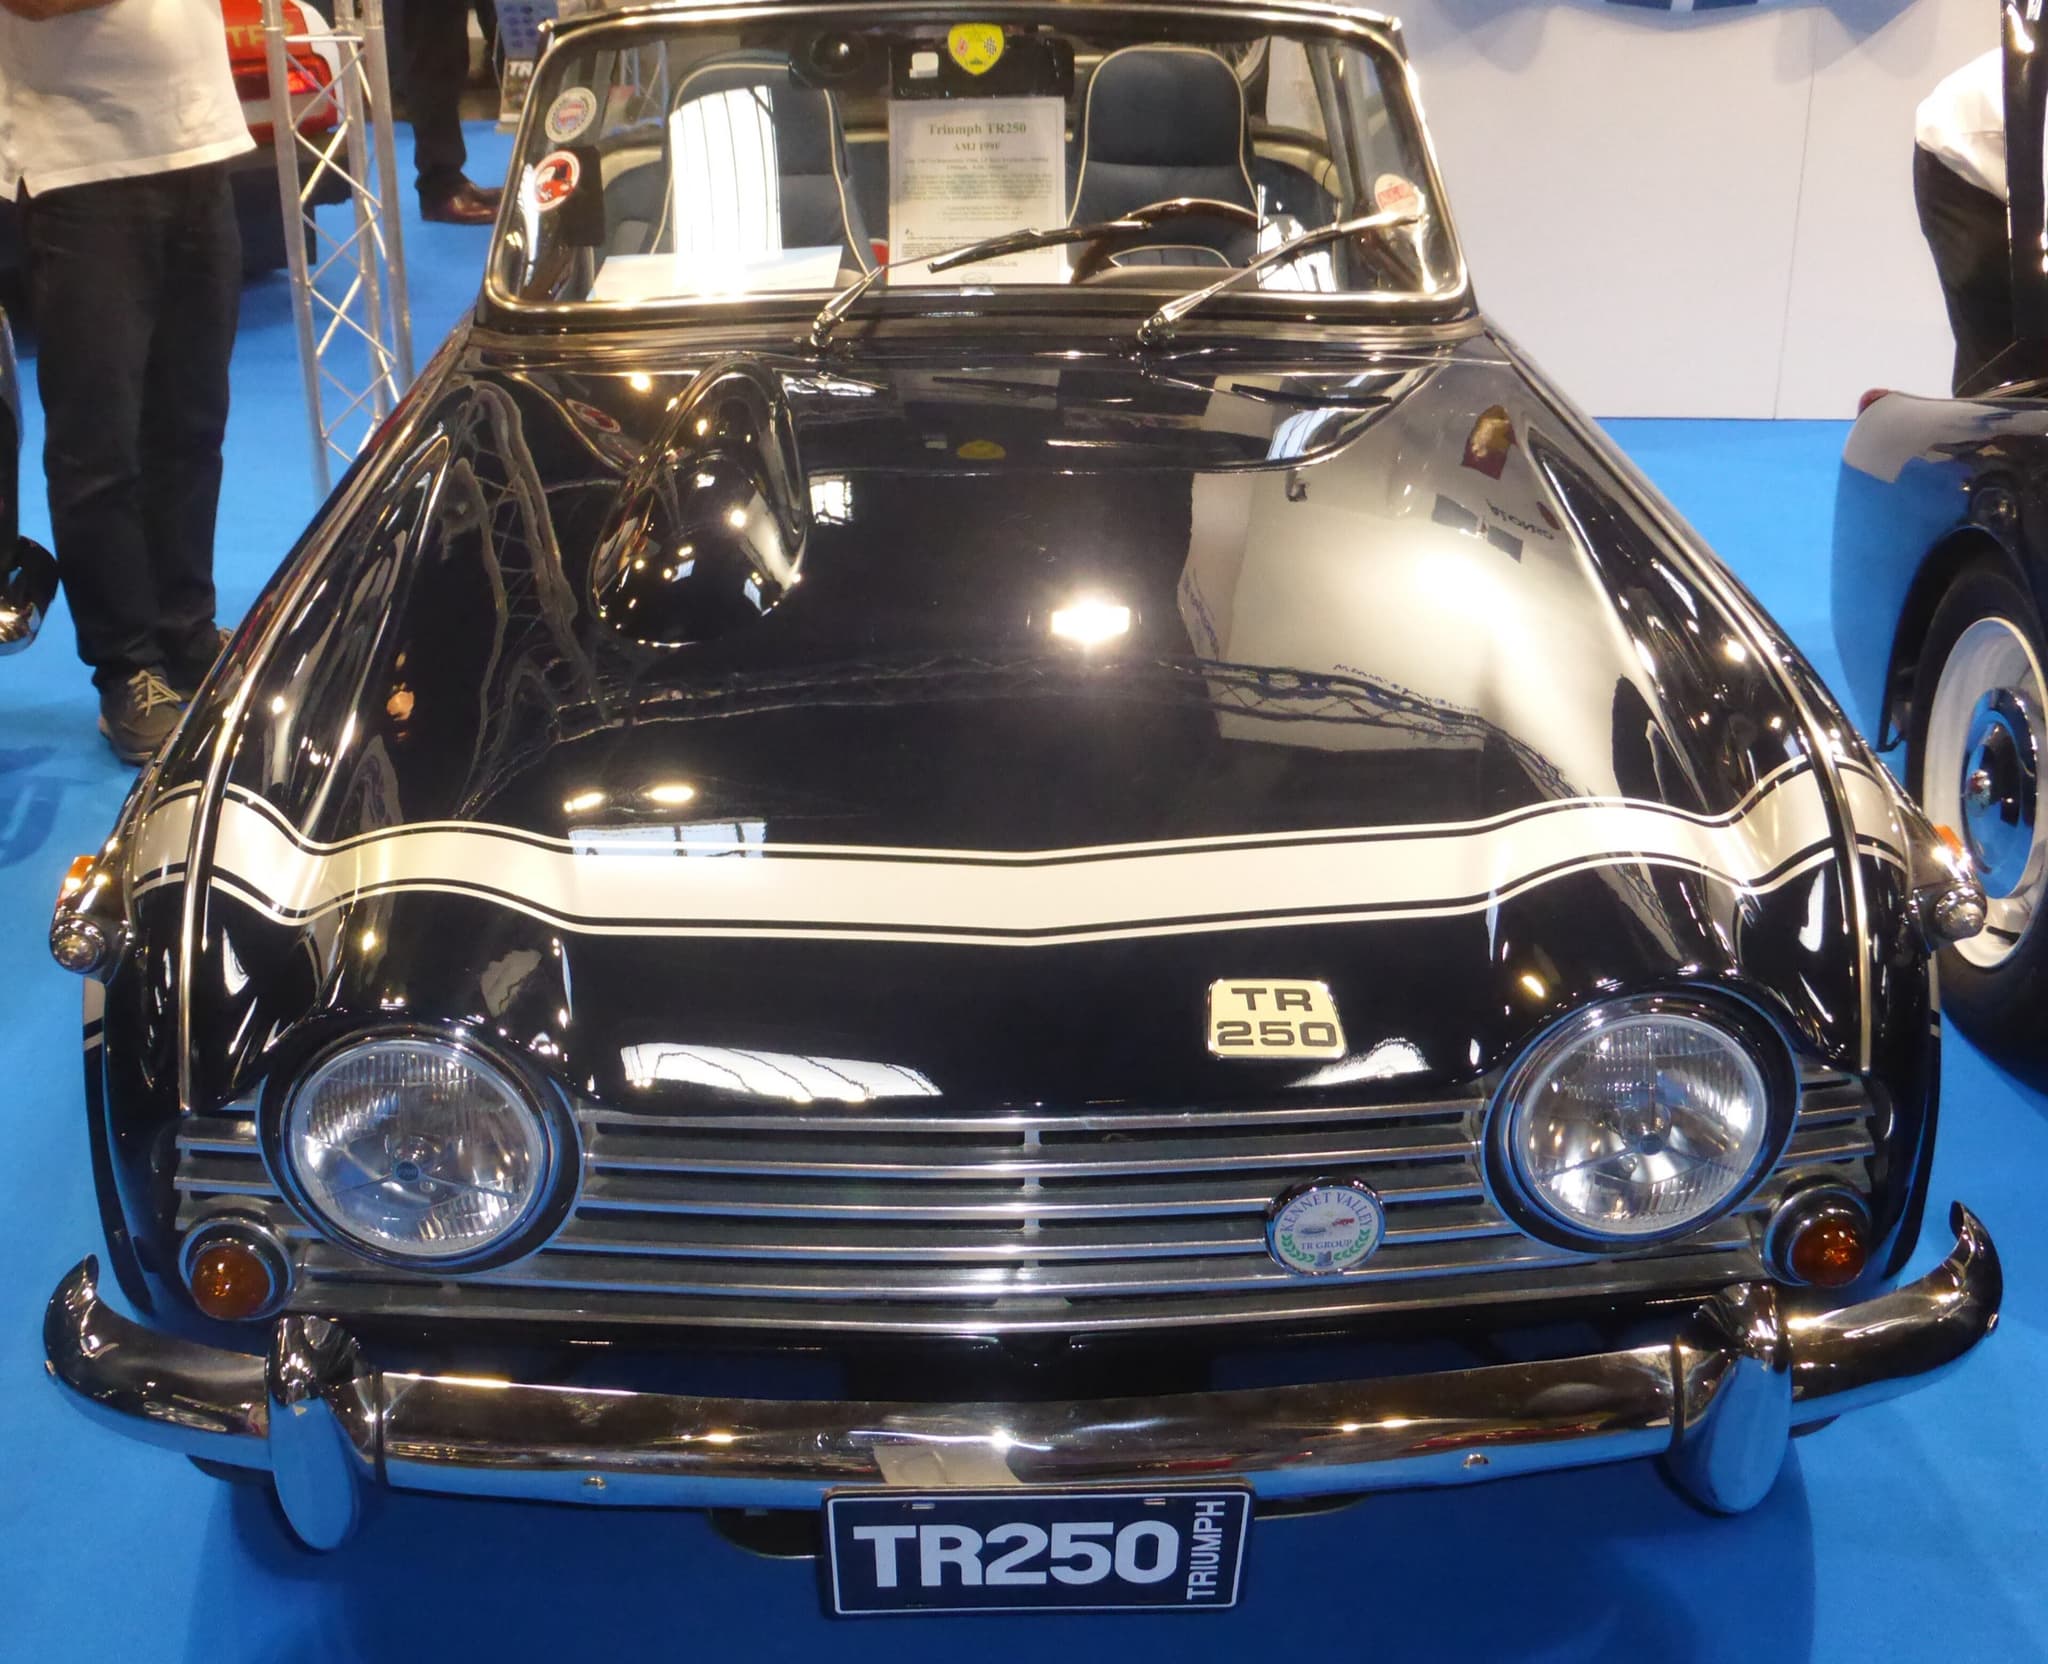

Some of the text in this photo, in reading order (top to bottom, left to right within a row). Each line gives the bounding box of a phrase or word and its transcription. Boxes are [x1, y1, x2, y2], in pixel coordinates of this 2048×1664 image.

[927, 122, 1026, 137] Triumph TR250
[1231, 987, 1313, 1012] TR
[1216, 1020, 1337, 1047] 250
[1280, 1191, 1374, 1233] KENNET VALLEY
[1301, 1239, 1353, 1250] TR GROUP
[852, 1519, 1180, 1589] TR250
[1186, 1500, 1226, 1601] TRIUMPH
